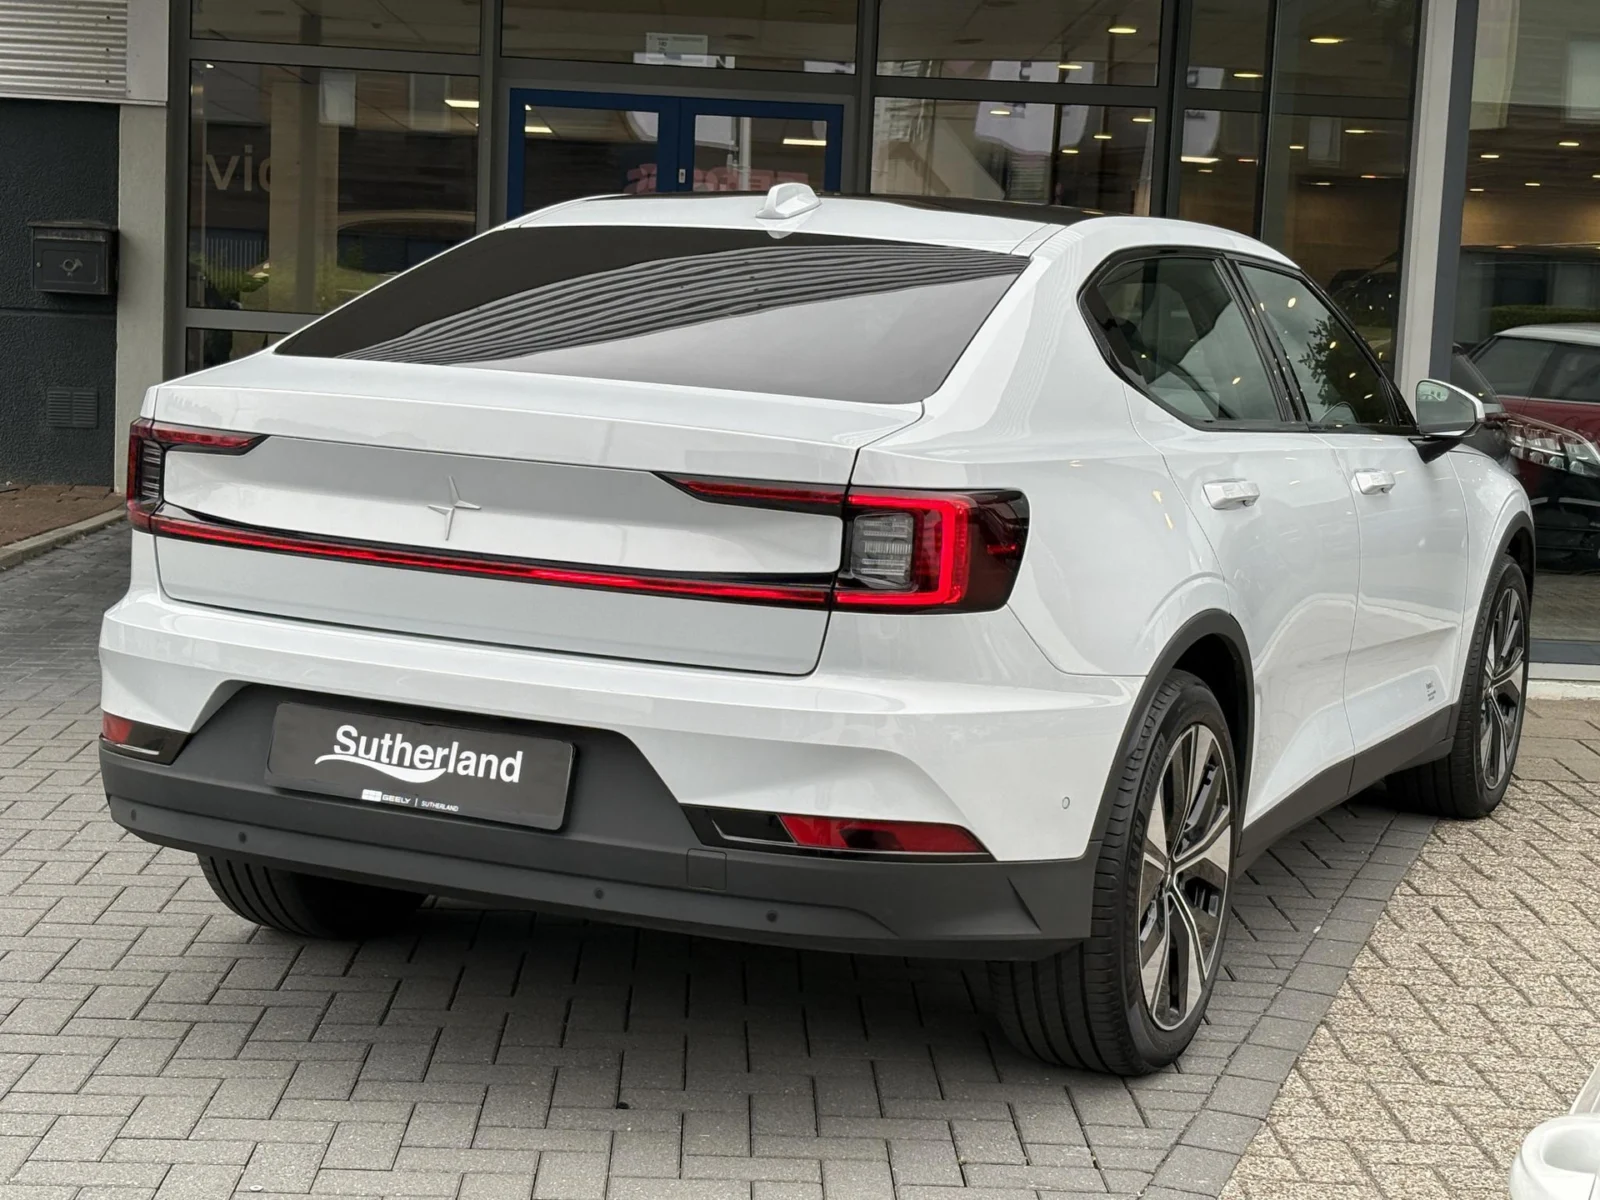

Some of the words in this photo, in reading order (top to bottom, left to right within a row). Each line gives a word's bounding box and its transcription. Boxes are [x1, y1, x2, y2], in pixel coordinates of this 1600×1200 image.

[333, 724, 523, 783] Sutherland
[382, 794, 411, 804] GEELY
[421, 800, 459, 812] SUTHERLAND
